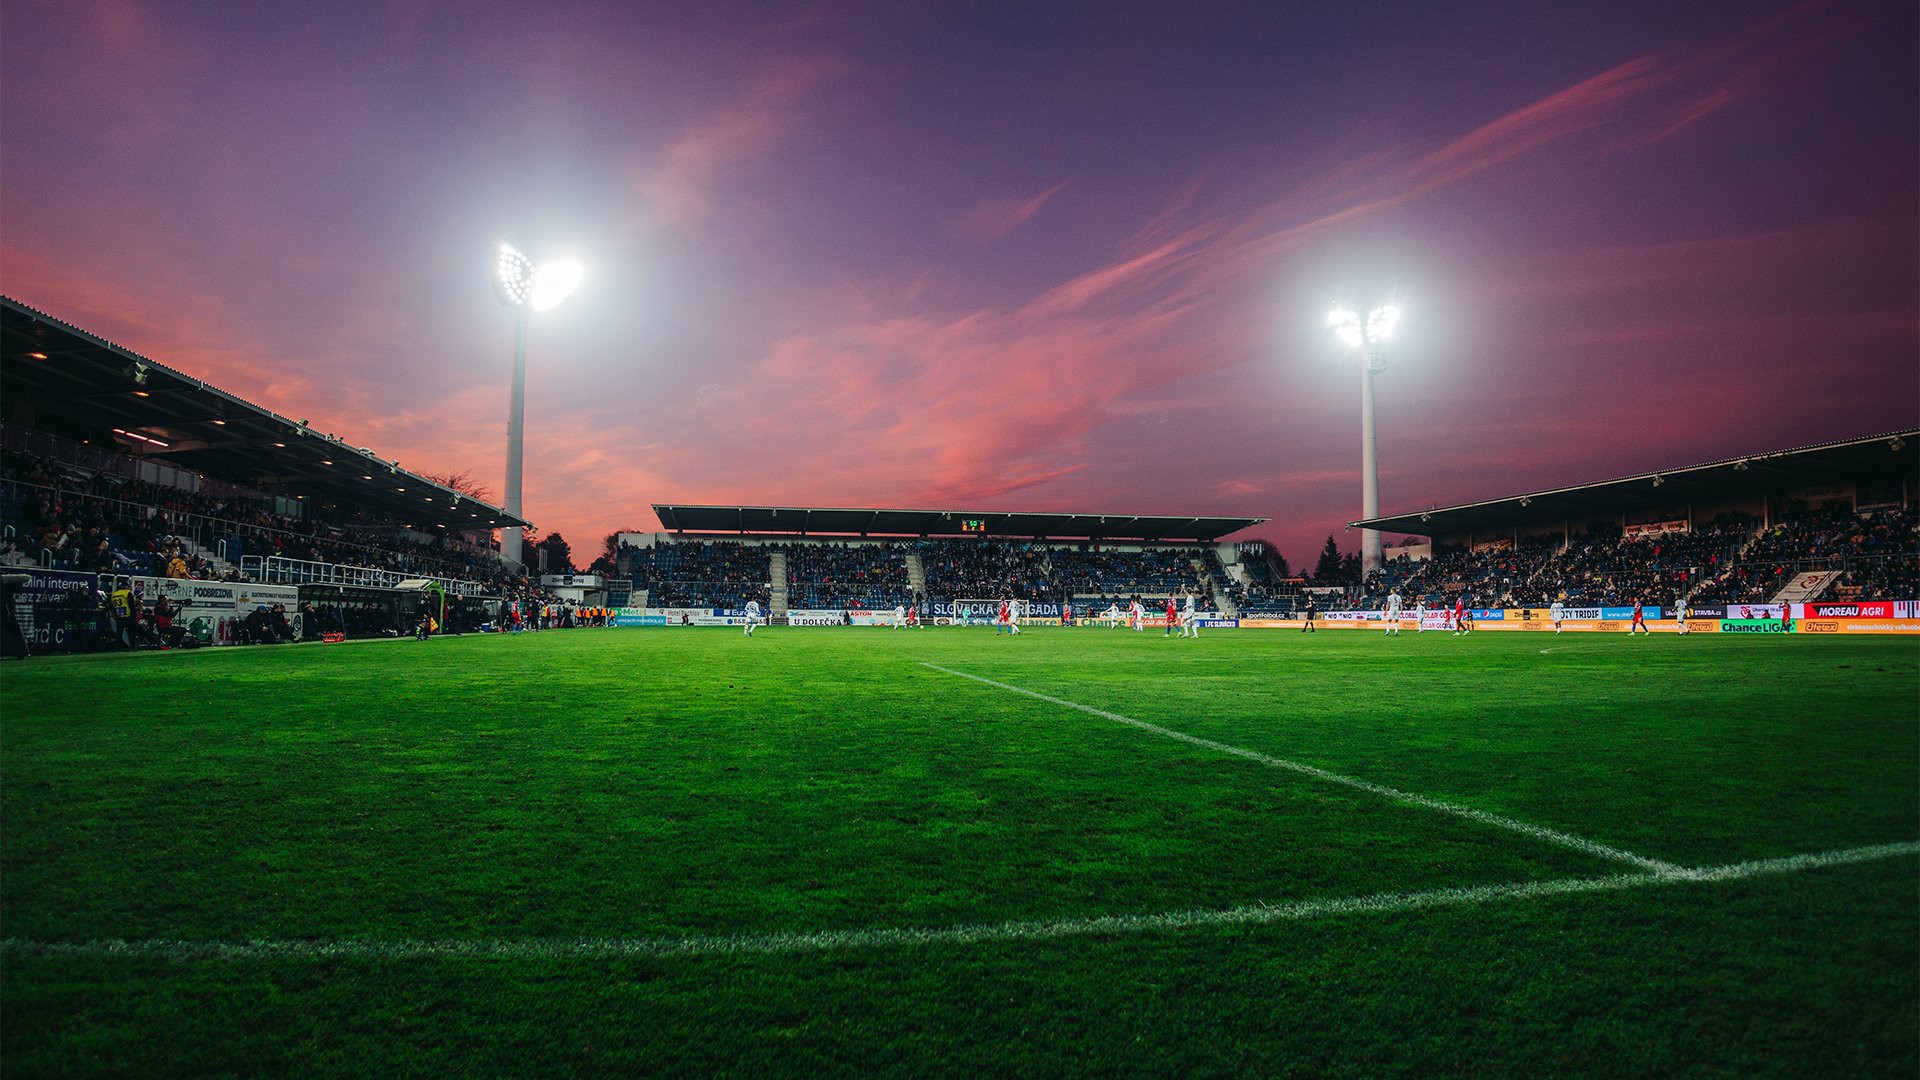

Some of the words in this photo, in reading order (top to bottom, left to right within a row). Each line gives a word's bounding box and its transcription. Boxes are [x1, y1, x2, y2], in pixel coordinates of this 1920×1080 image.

[1818, 607, 1859, 616] MOREAU
[1861, 607, 1884, 616] AGRI
[1722, 623, 1762, 632] Chance
